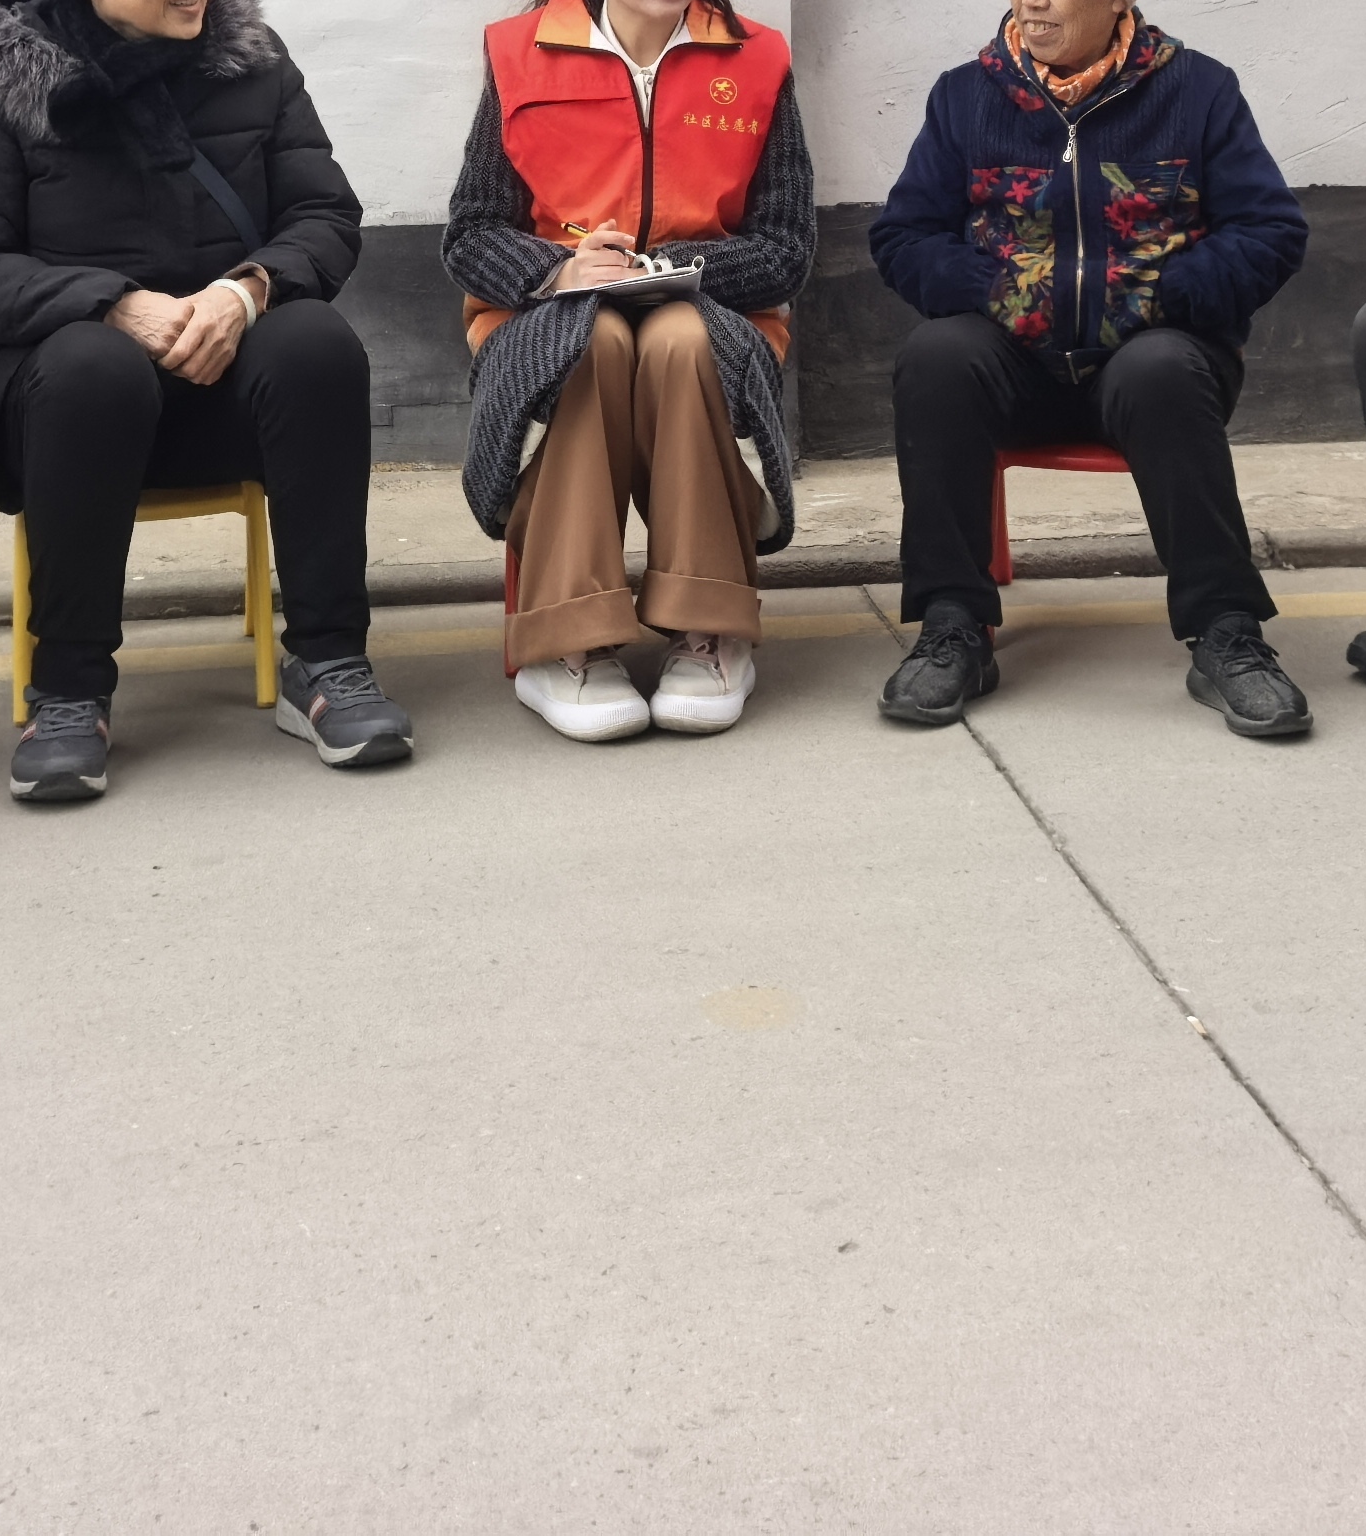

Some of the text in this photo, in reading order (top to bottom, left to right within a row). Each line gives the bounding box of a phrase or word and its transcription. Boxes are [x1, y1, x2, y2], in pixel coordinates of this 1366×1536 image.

[683, 111, 759, 136] 社区志愿者
